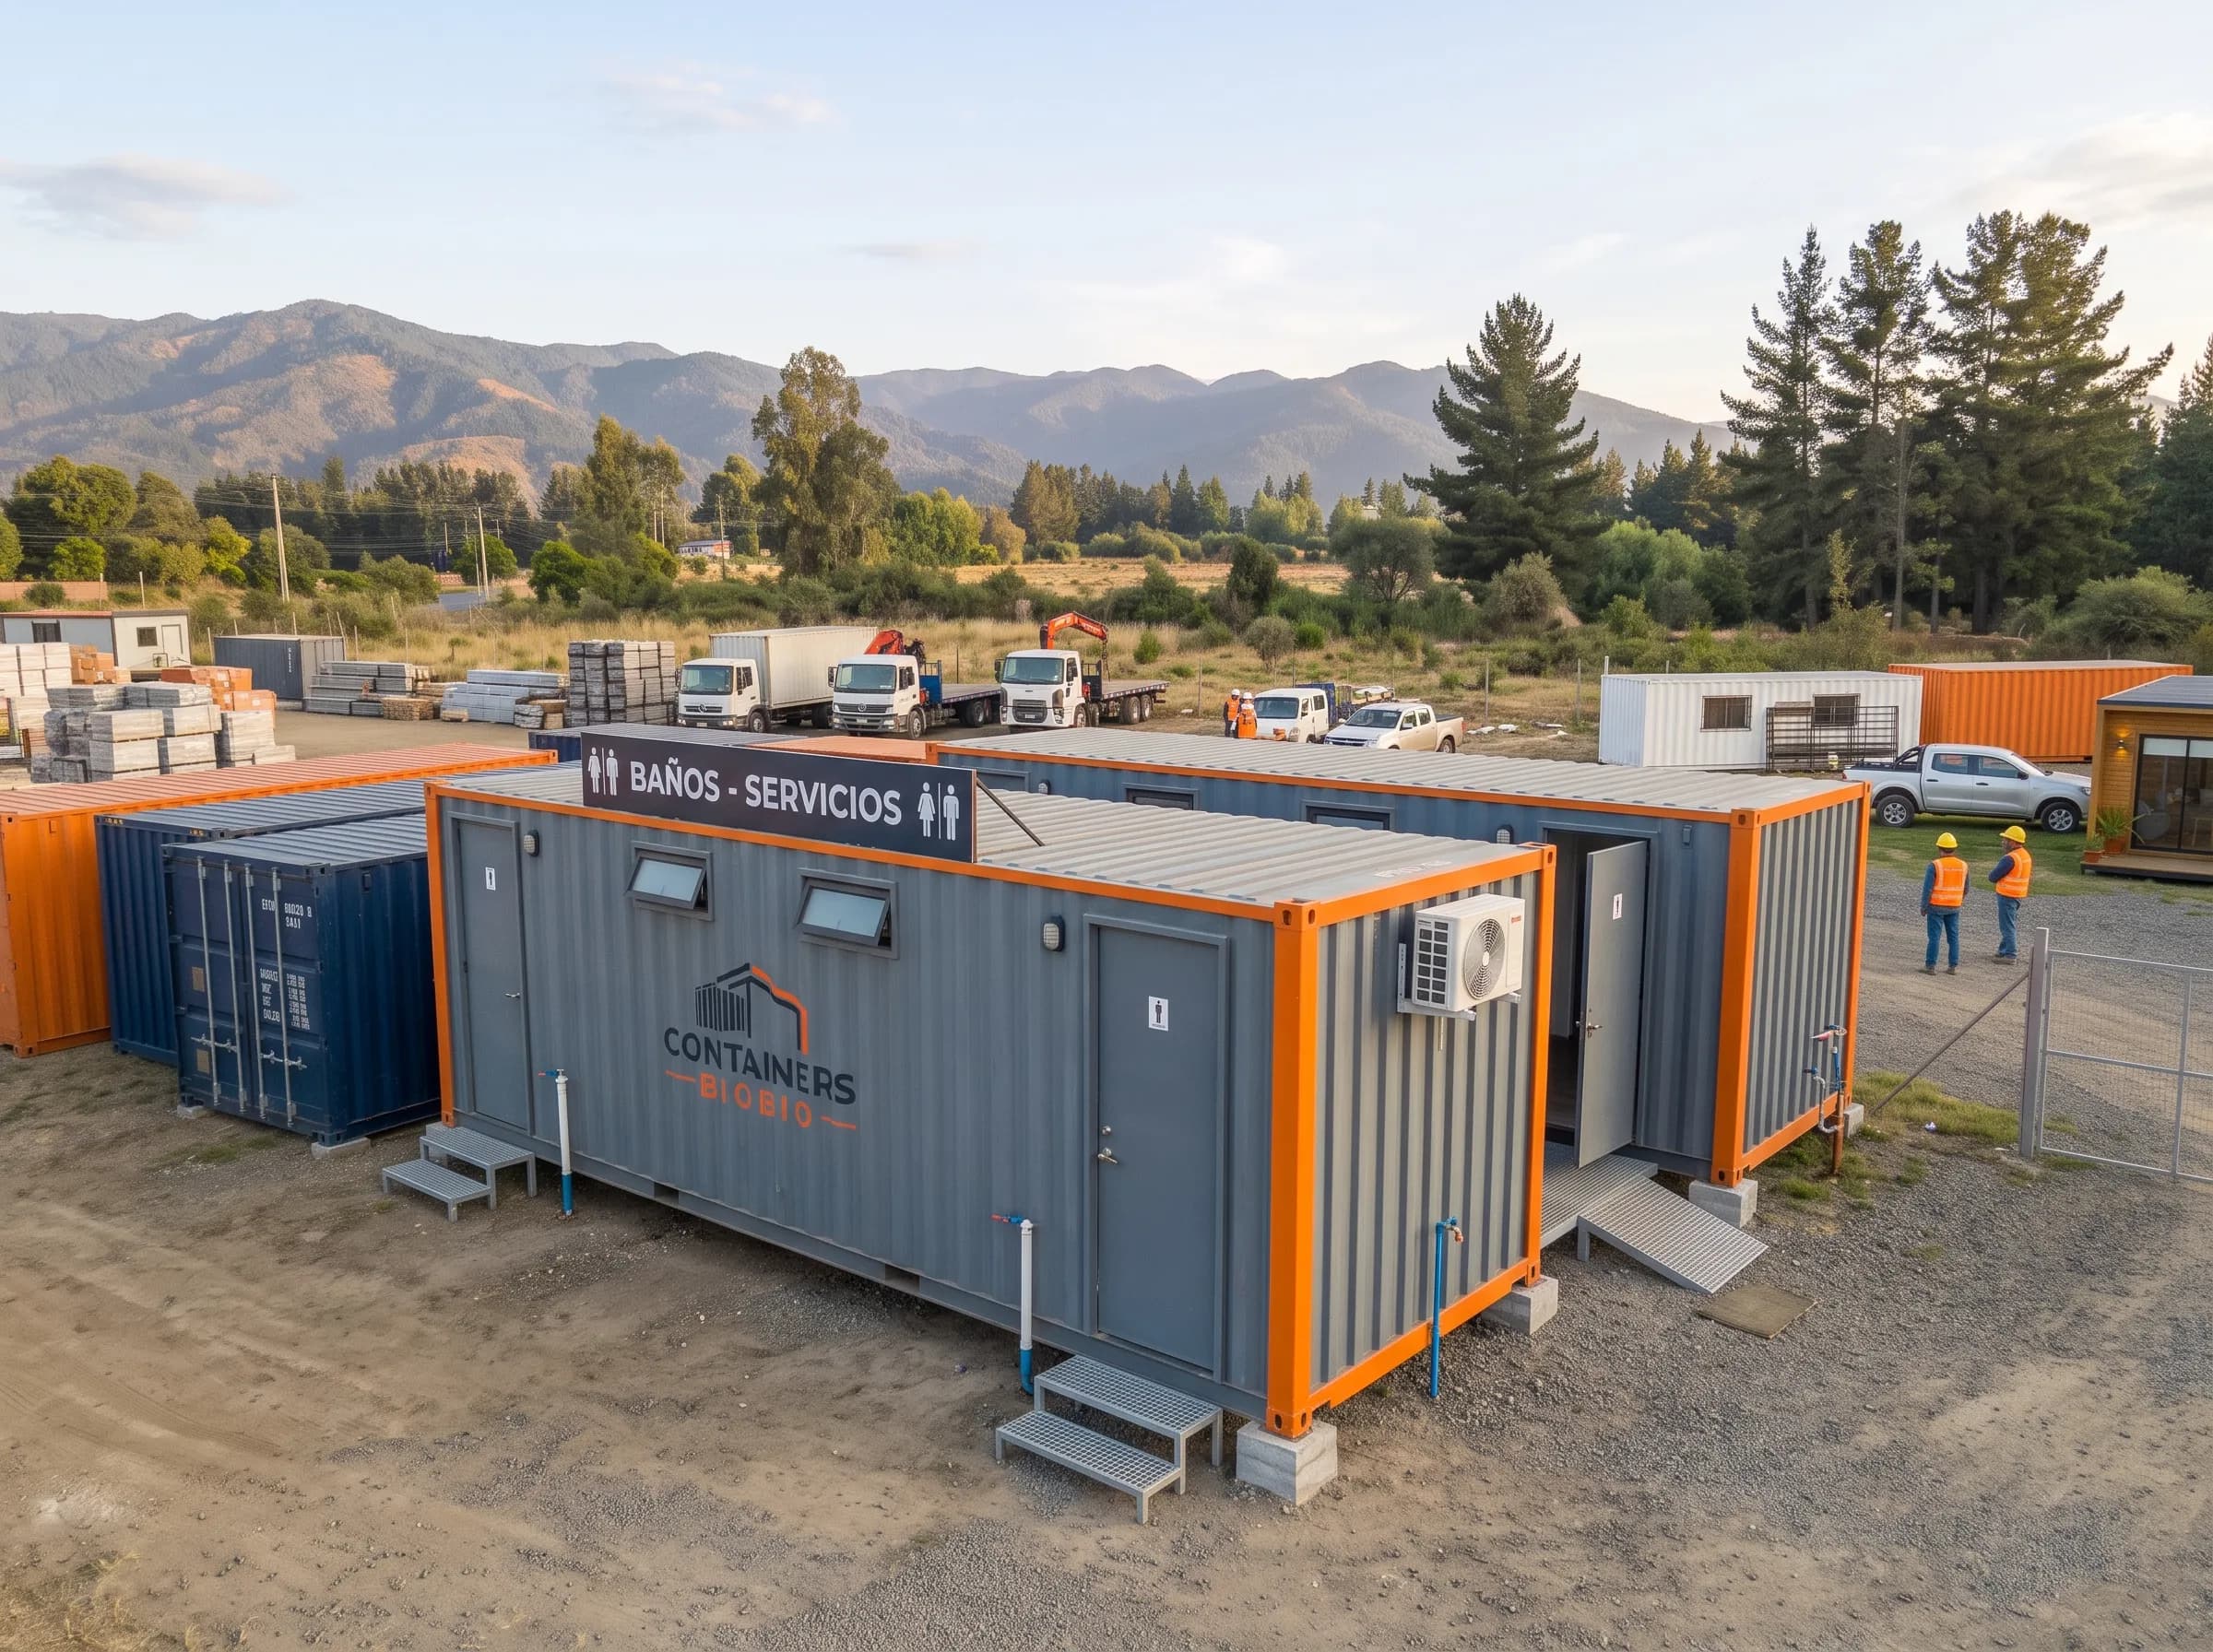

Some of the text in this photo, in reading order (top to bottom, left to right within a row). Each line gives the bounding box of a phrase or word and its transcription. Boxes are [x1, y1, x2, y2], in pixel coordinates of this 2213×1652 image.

[630, 757, 720, 802] BAÑOS
[745, 774, 902, 826] SERVICIOS
[664, 1027, 857, 1105] CONTAINERS
[700, 1072, 812, 1128] BIOBIO
